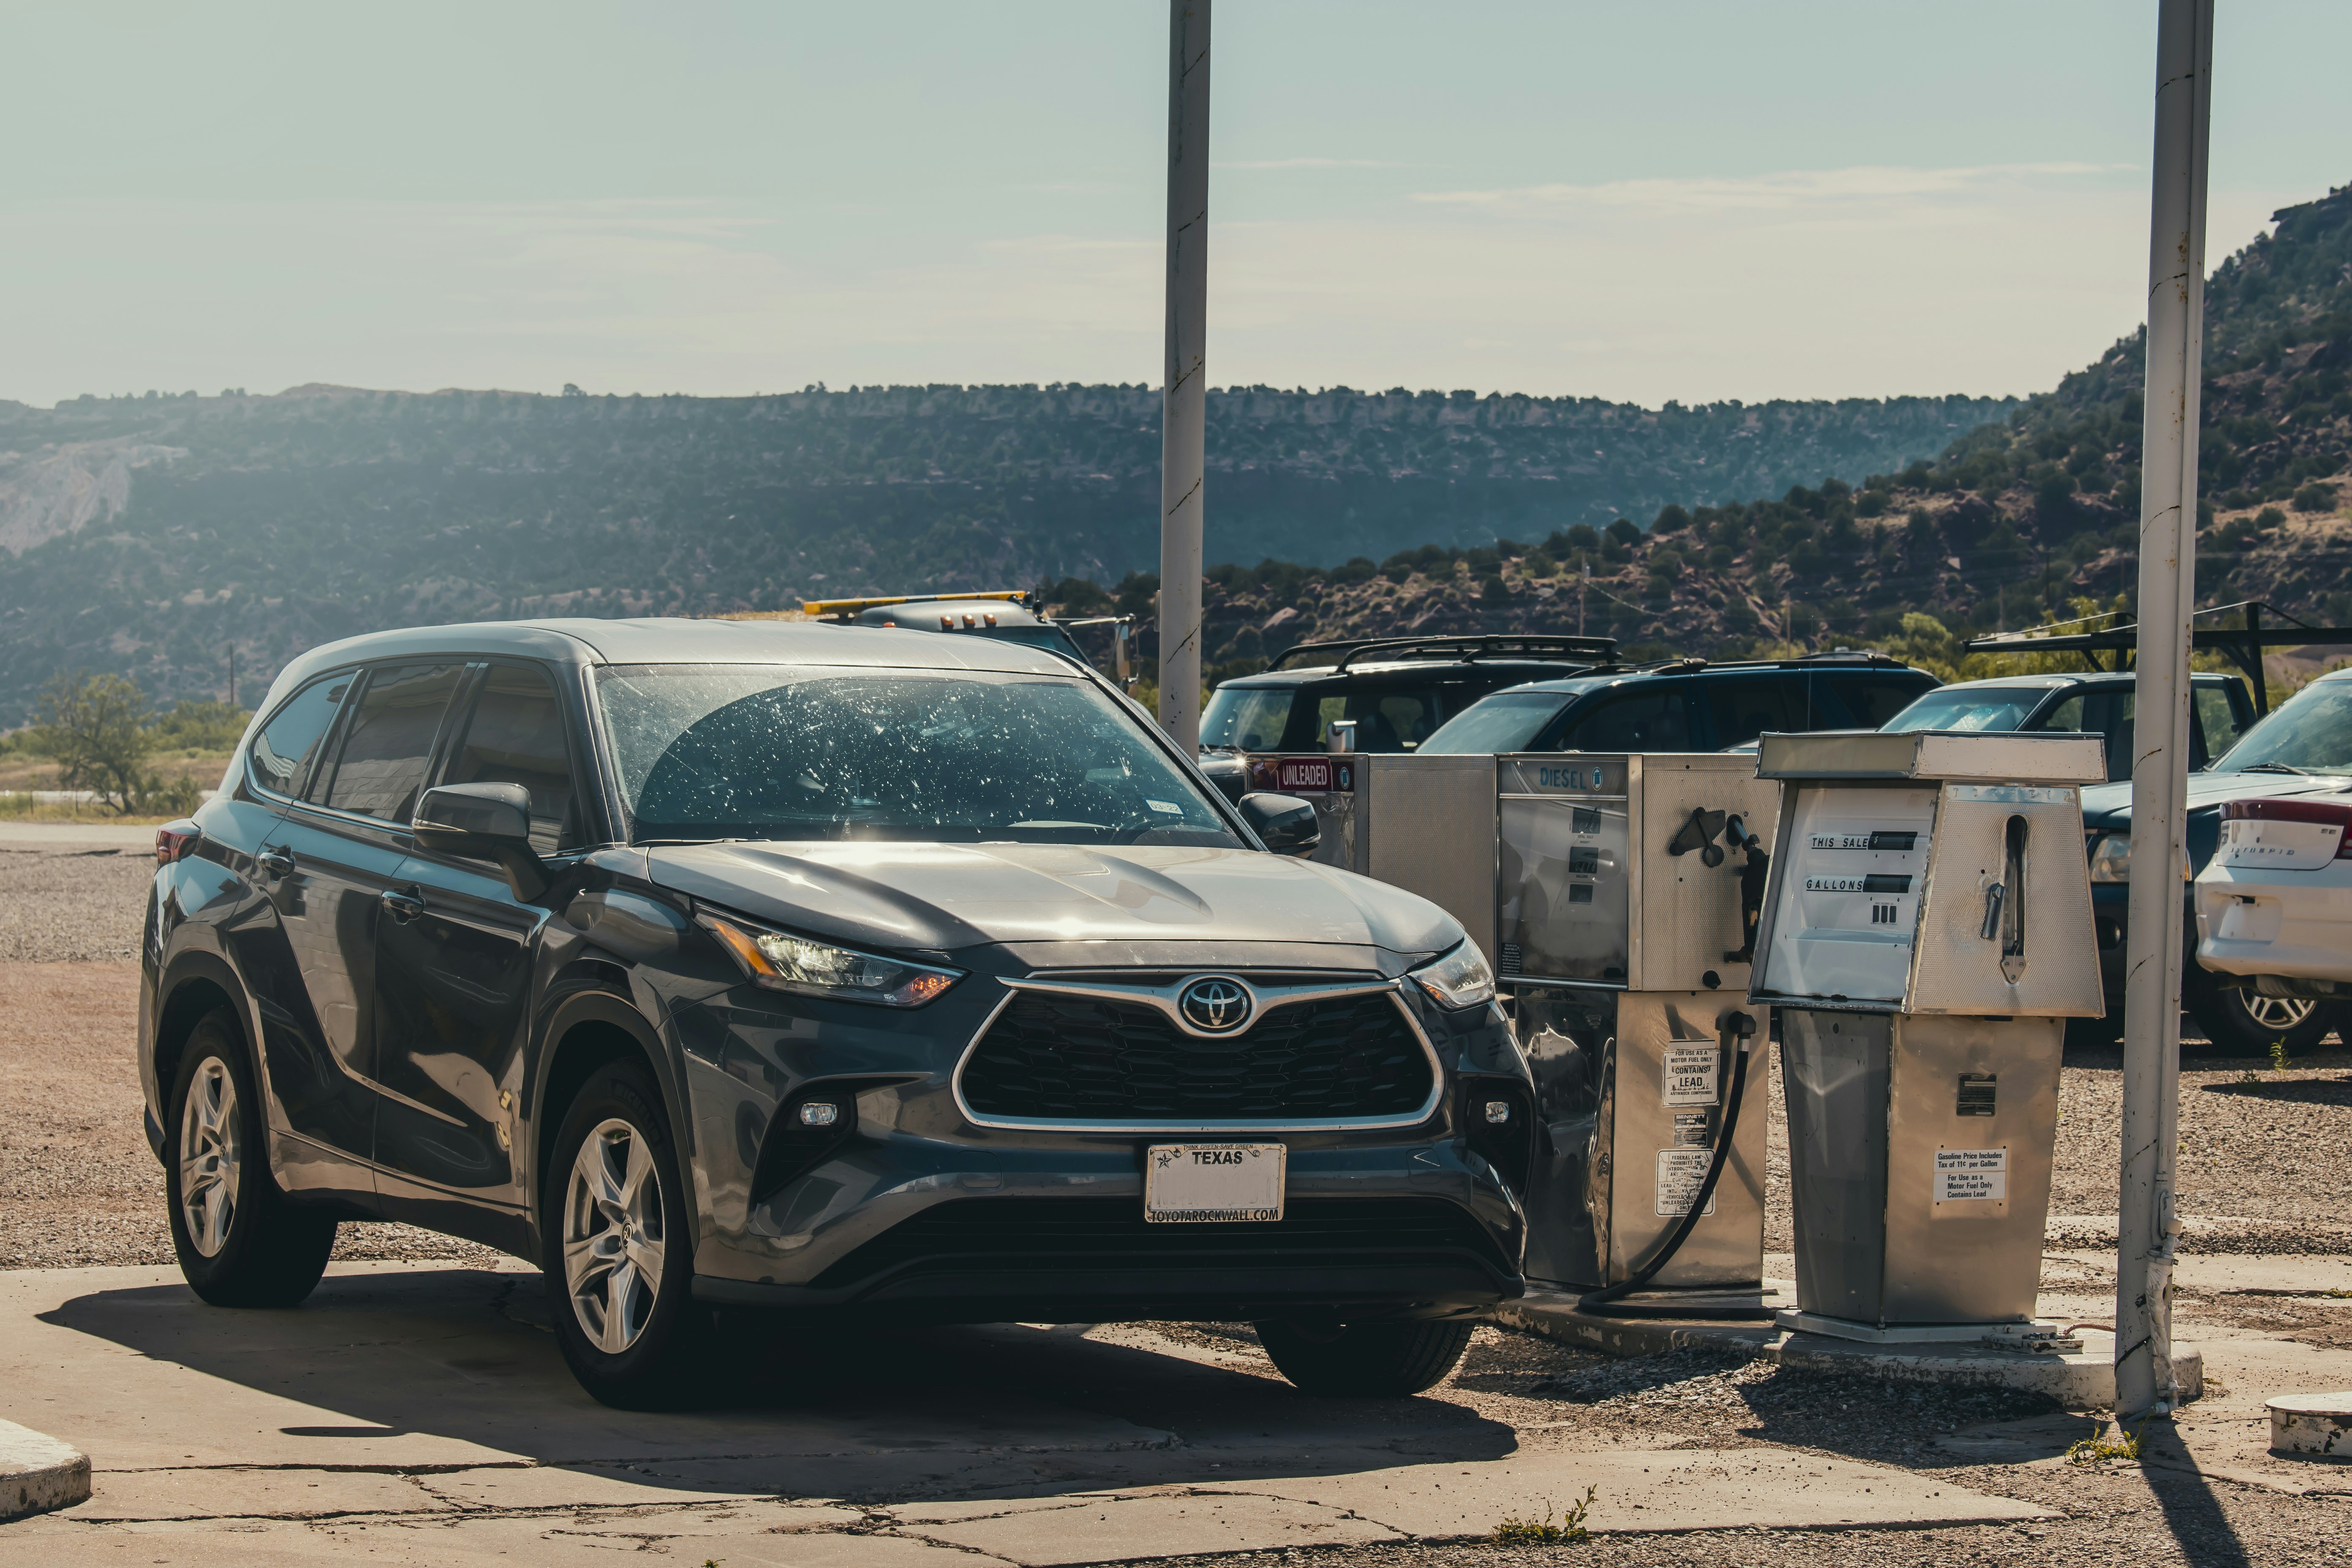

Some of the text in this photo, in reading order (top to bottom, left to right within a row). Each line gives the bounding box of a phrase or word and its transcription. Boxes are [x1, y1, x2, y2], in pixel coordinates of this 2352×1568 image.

[1283, 765, 1327, 785] UNLEADED
[1540, 767, 1587, 790] DIESEL
[1813, 838, 1834, 847] THIS
[1843, 838, 1868, 847] SALE
[1806, 879, 1863, 890] GALLONS
[1680, 1077, 1702, 1086] LEAD
[1192, 1151, 1242, 1165] TEXAS
[1152, 1210, 1278, 1222] TOYOTAROCKWALL.COM
